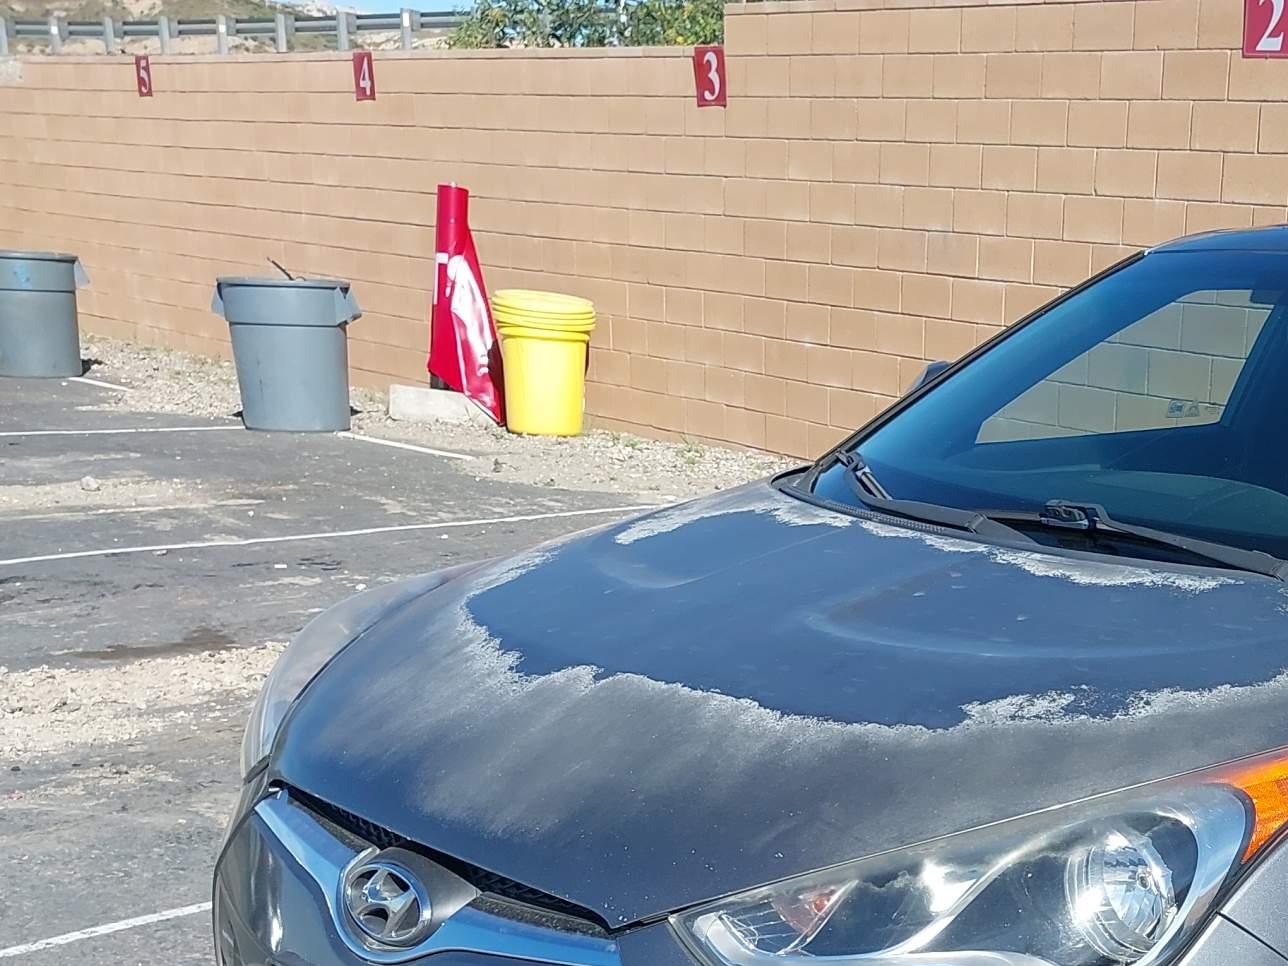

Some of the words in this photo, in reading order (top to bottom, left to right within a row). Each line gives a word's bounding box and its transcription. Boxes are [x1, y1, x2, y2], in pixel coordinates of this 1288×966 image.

[1255, 0, 1285, 51] 2
[139, 59, 149, 93] 5
[359, 56, 372, 96] 4
[703, 51, 720, 101] 3
